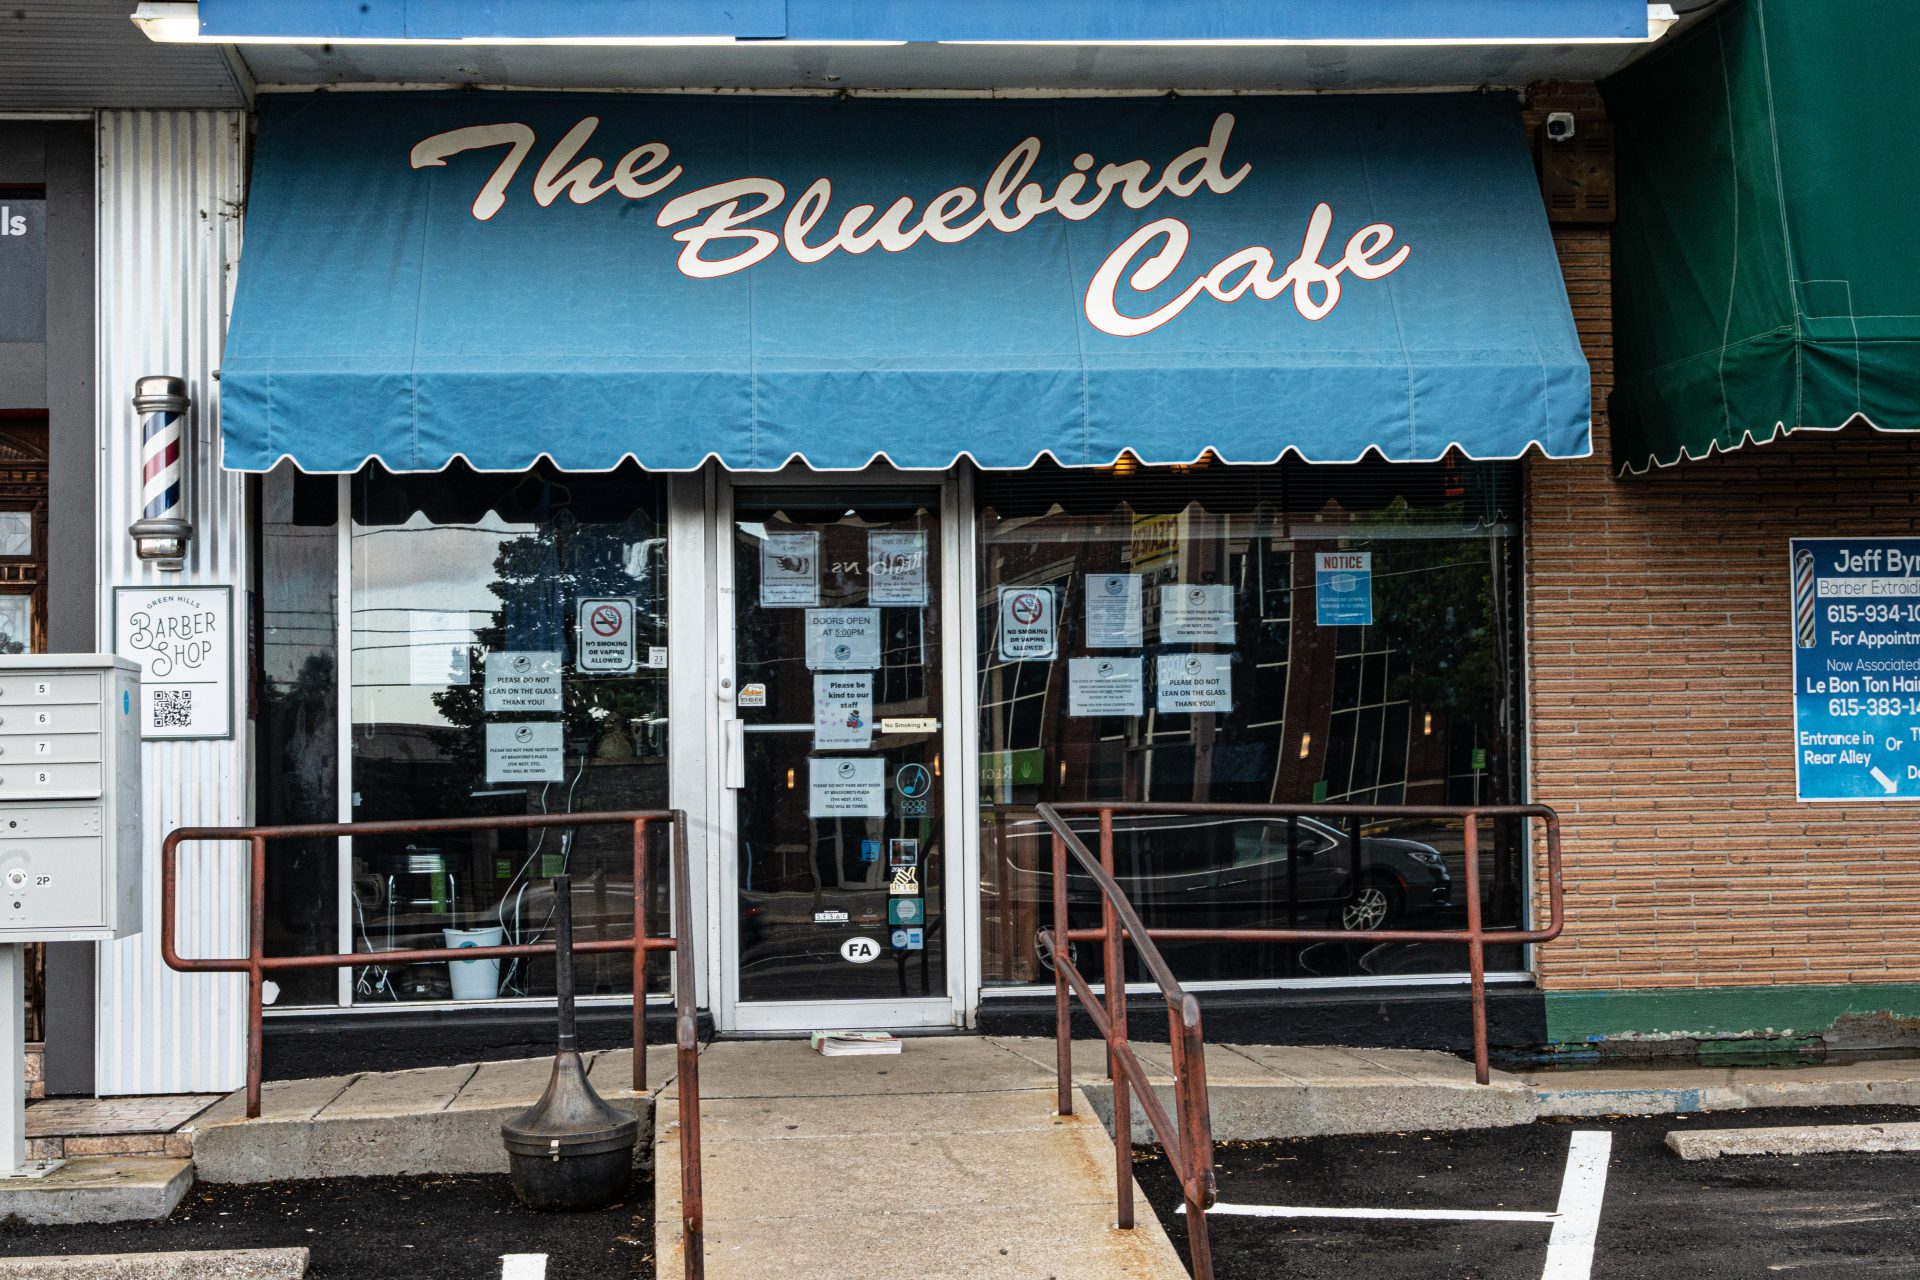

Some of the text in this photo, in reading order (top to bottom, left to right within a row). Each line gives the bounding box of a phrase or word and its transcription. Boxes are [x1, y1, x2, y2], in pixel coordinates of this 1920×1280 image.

[410, 116, 682, 220] The
[656, 113, 1252, 280] Bluebird
[1084, 203, 1410, 337] Cafe
[1323, 556, 1363, 569] NOTICE
[1833, 549, 1881, 572] Jeff
[1820, 580, 1867, 595] Barber
[147, 596, 200, 609] GREEN HILLS
[130, 611, 216, 650] BARBER
[823, 629, 864, 637] AT 5:00PM
[1831, 631, 1854, 645] For
[152, 640, 212, 677] SHOP
[1827, 658, 1920, 671] Now Associated
[39, 684, 46, 694] 5
[1807, 677, 1825, 694] Le
[1829, 677, 1859, 693] Bon
[1862, 677, 1889, 693] Ton
[39, 713, 46, 723] 6
[895, 722, 920, 730] Smoking
[1800, 732, 1874, 746] Entrance in
[1910, 727, 1920, 741] T
[39, 743, 46, 753] 7
[1885, 736, 1903, 751] Or
[1804, 750, 1871, 767] Rear Alley
[39, 773, 46, 783] 8
[36, 876, 50, 886] 2P
[848, 944, 872, 957] FA
